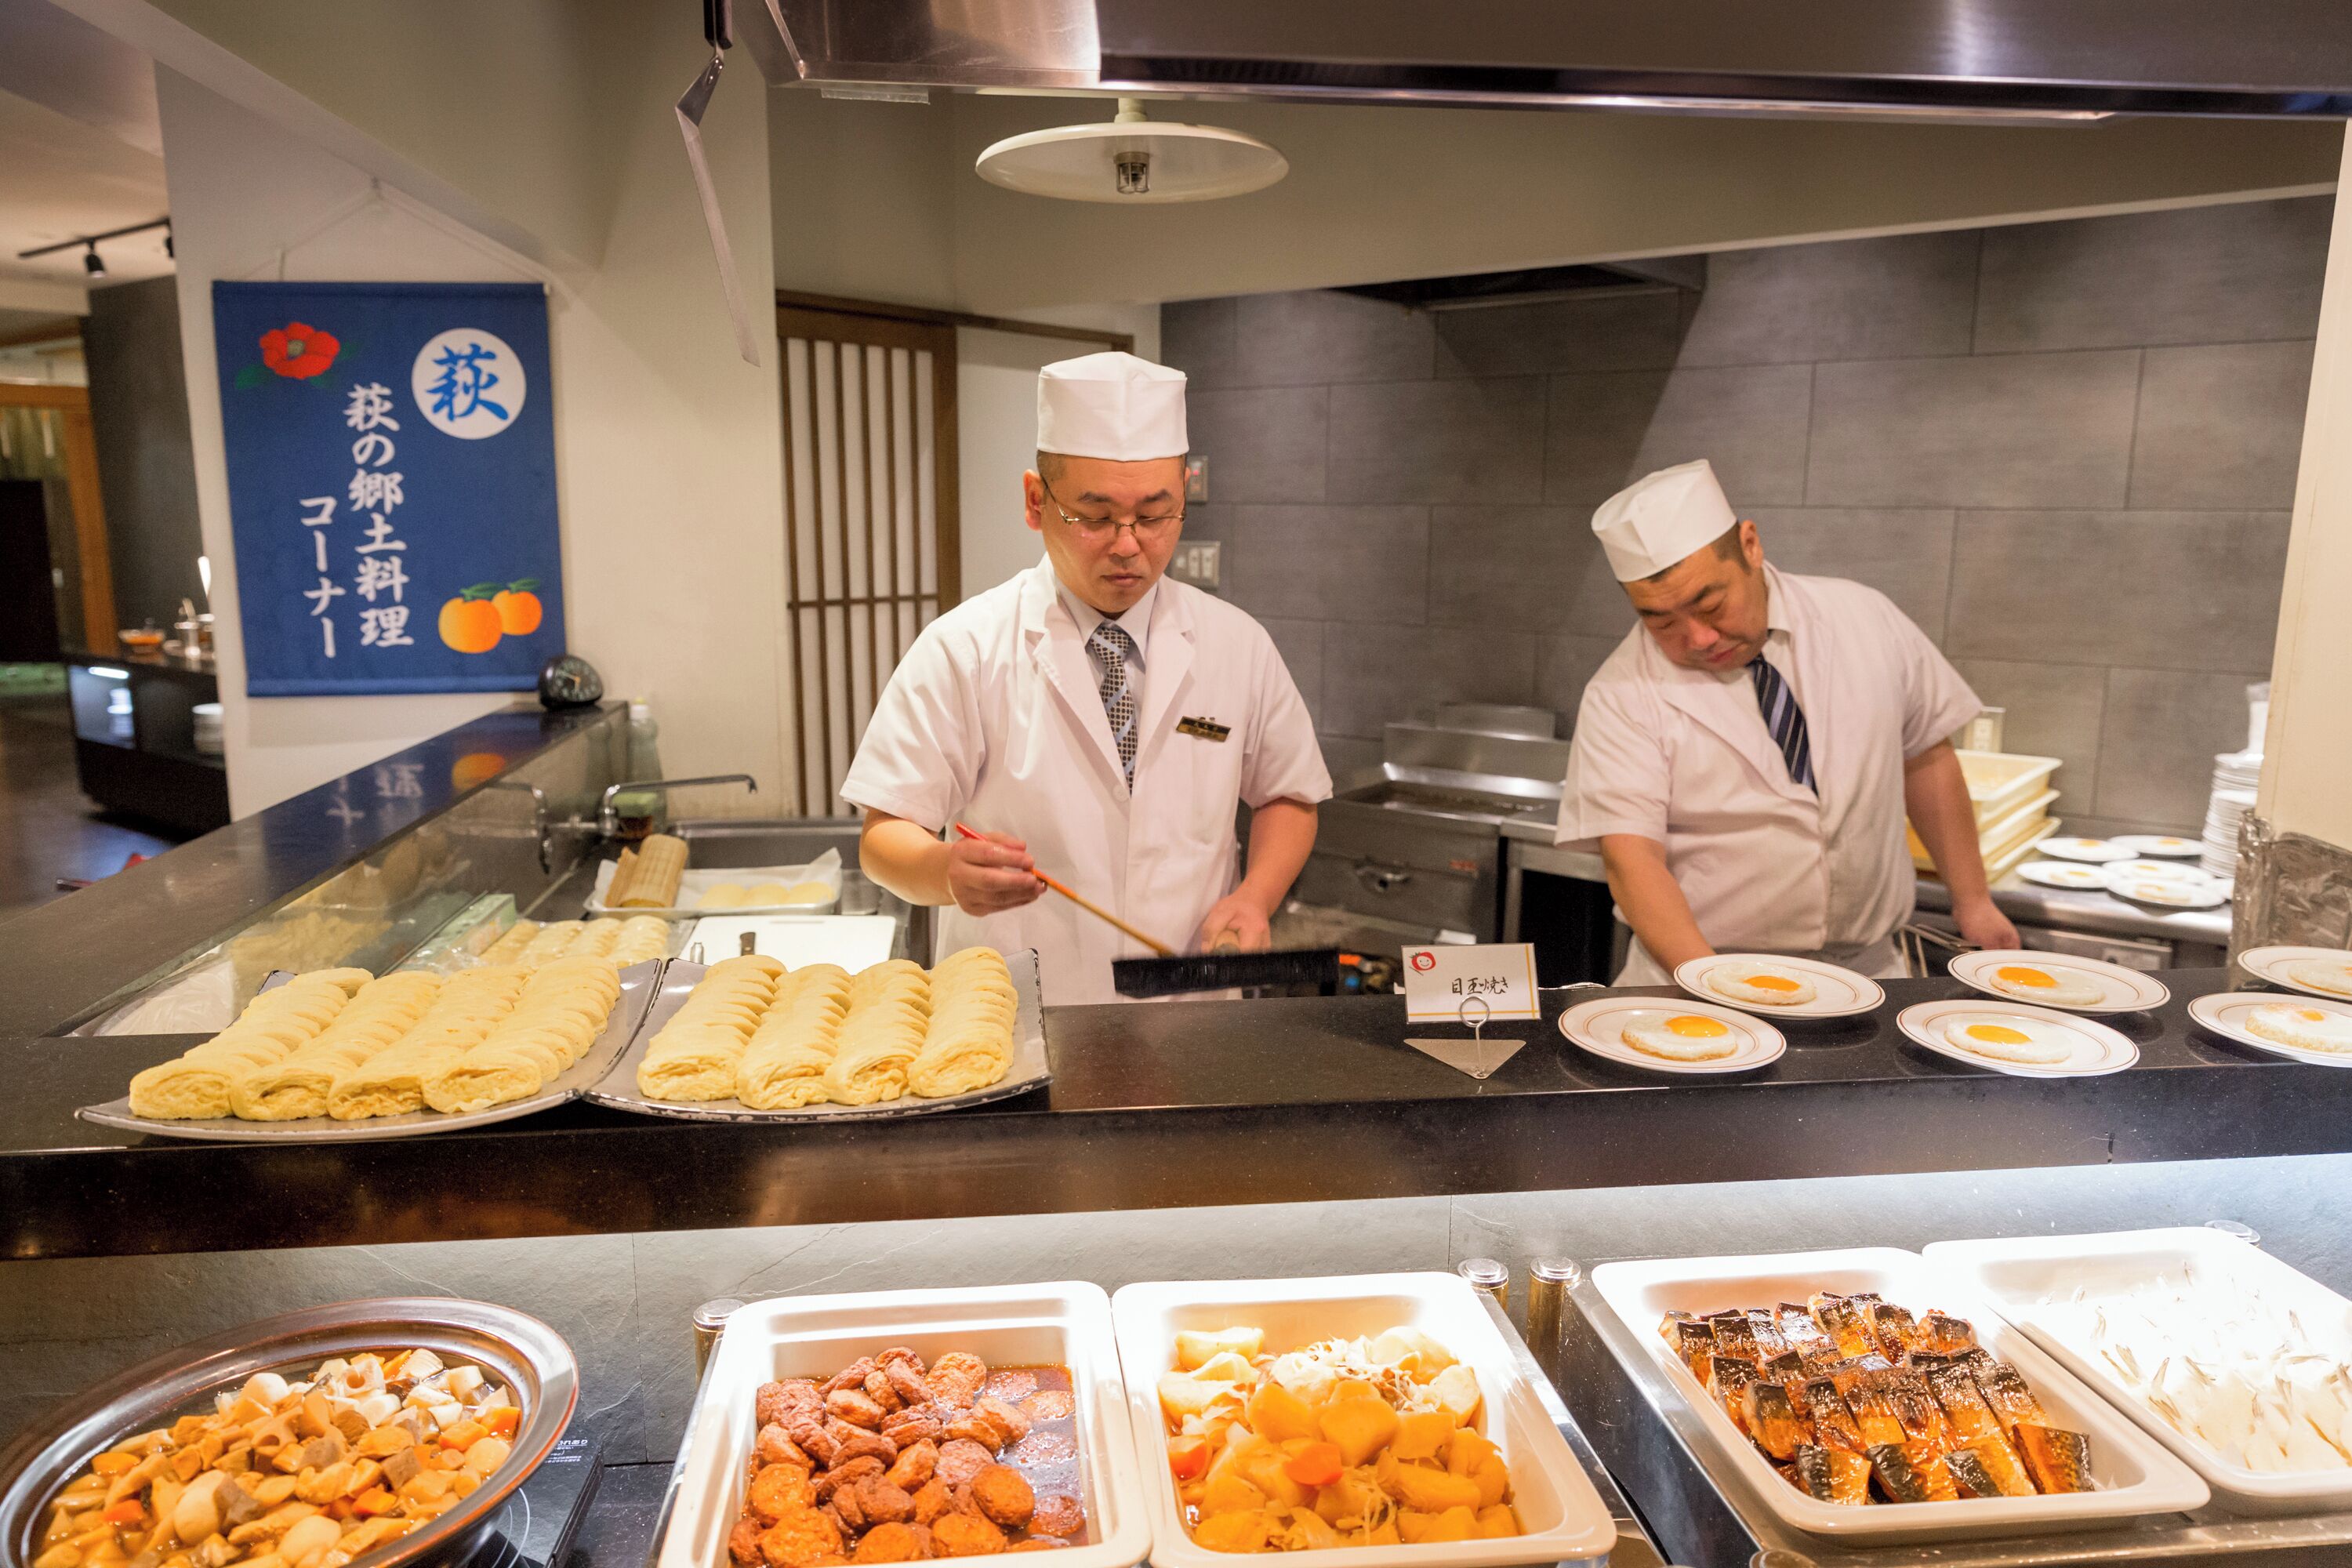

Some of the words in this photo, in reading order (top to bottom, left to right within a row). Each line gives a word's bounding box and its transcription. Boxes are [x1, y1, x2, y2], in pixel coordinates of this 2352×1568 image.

[426, 343, 510, 422] 萩
[343, 382, 415, 648] 萩の郷土料理
[299, 495, 347, 658] コーナー
[1451, 976, 1508, 995] 目玉焼き
